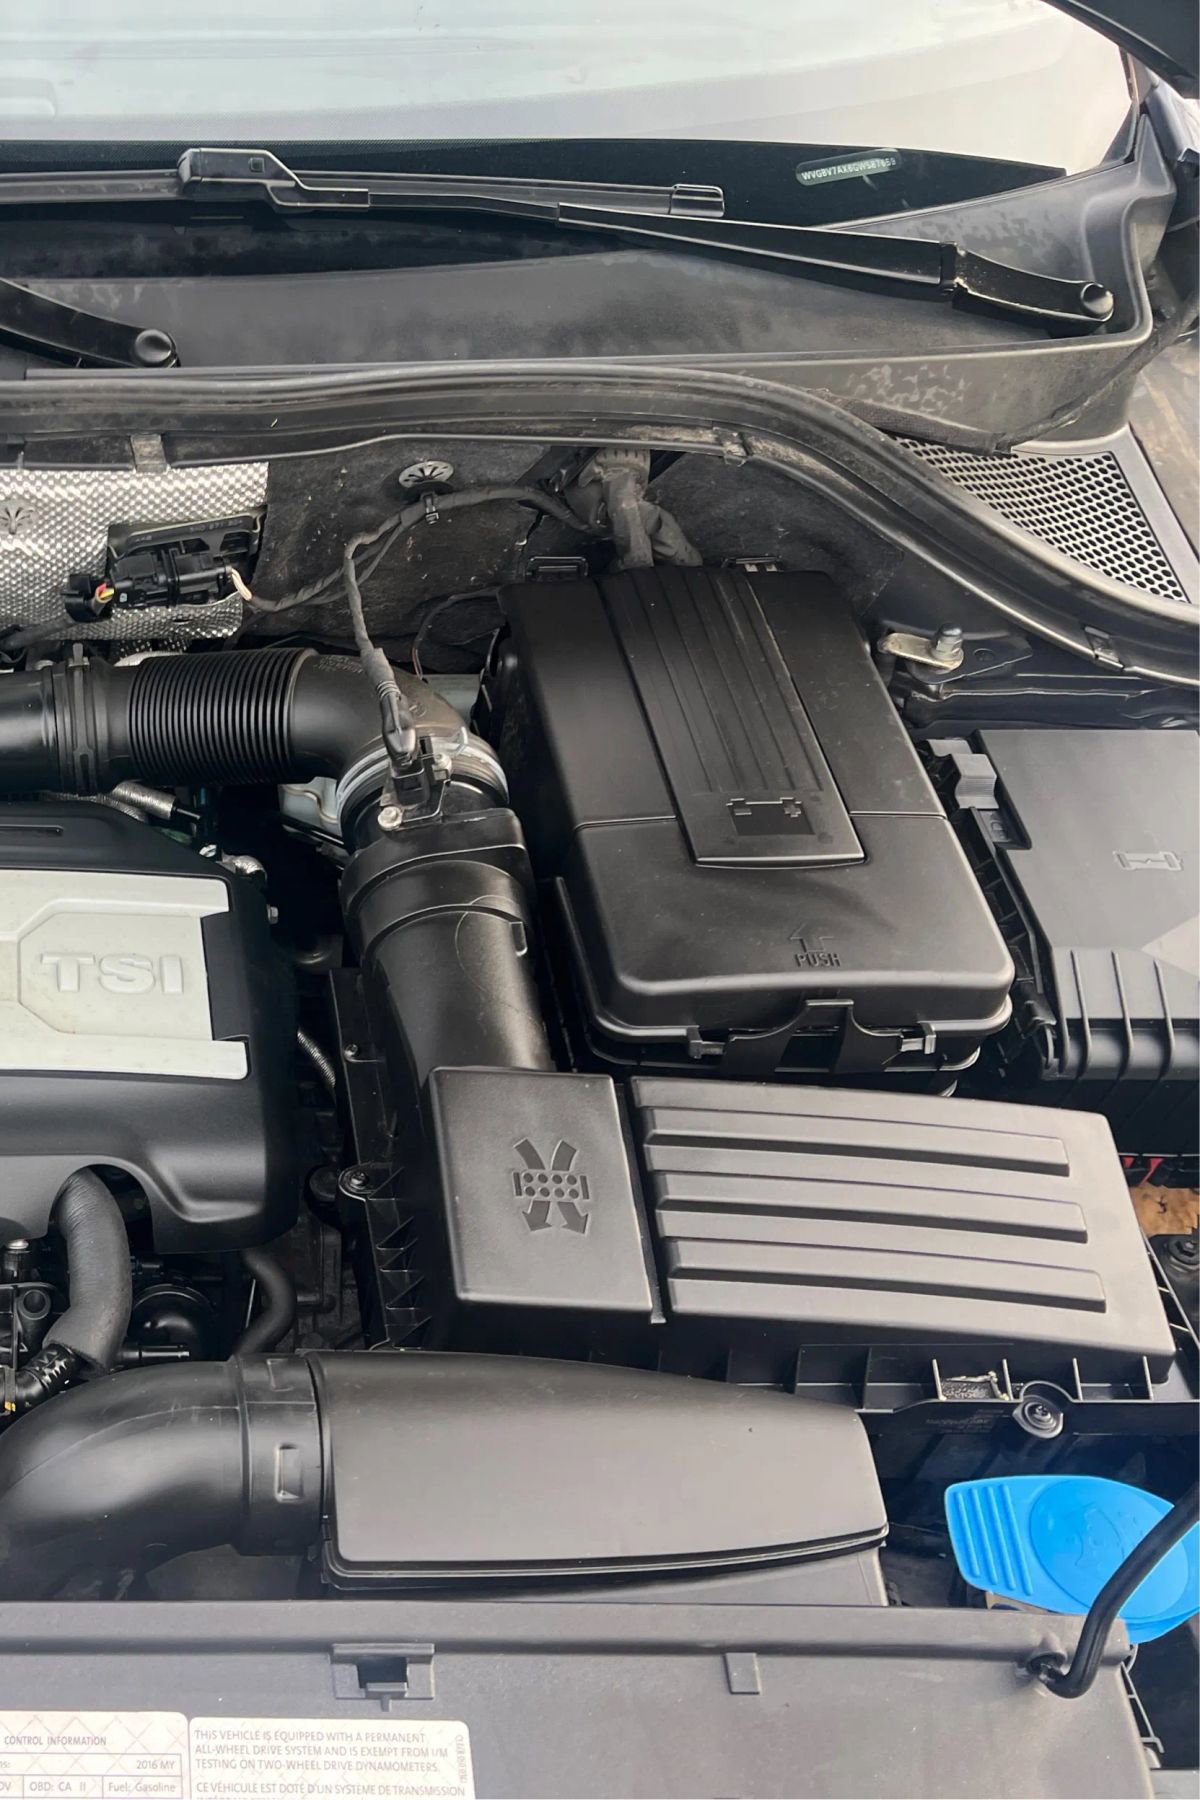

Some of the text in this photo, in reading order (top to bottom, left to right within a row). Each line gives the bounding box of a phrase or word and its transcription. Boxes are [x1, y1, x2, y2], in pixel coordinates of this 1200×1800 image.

[795, 953, 841, 967] PUSH
[41, 951, 184, 995] TSI
[4, 1736, 43, 1745] CONTROL
[47, 1736, 106, 1745] INFORMATION
[194, 1730, 425, 1743] THIS VEHICLE IS EQUIPPED WITH A PERMANENT
[195, 1745, 448, 1757] ALL-WHEEL DRIVE SYSTEM AND IS EXEMPT FROM I/M
[136, 1760, 175, 1769] 2016 MY
[195, 1759, 237, 1769] TESTING
[240, 1759, 255, 1769] ON
[259, 1760, 321, 1770] TWO-WHEEL
[324, 1760, 353, 1770] DRIVE
[29, 1782, 86, 1792] OBD: CA II
[109, 1782, 176, 1792] Fuel: Gasoline
[196, 1782, 208, 1793] CE
[261, 1782, 276, 1793] EST
[378, 1785, 392, 1795] DE
[393, 1785, 465, 1796] TRANSMISSION
